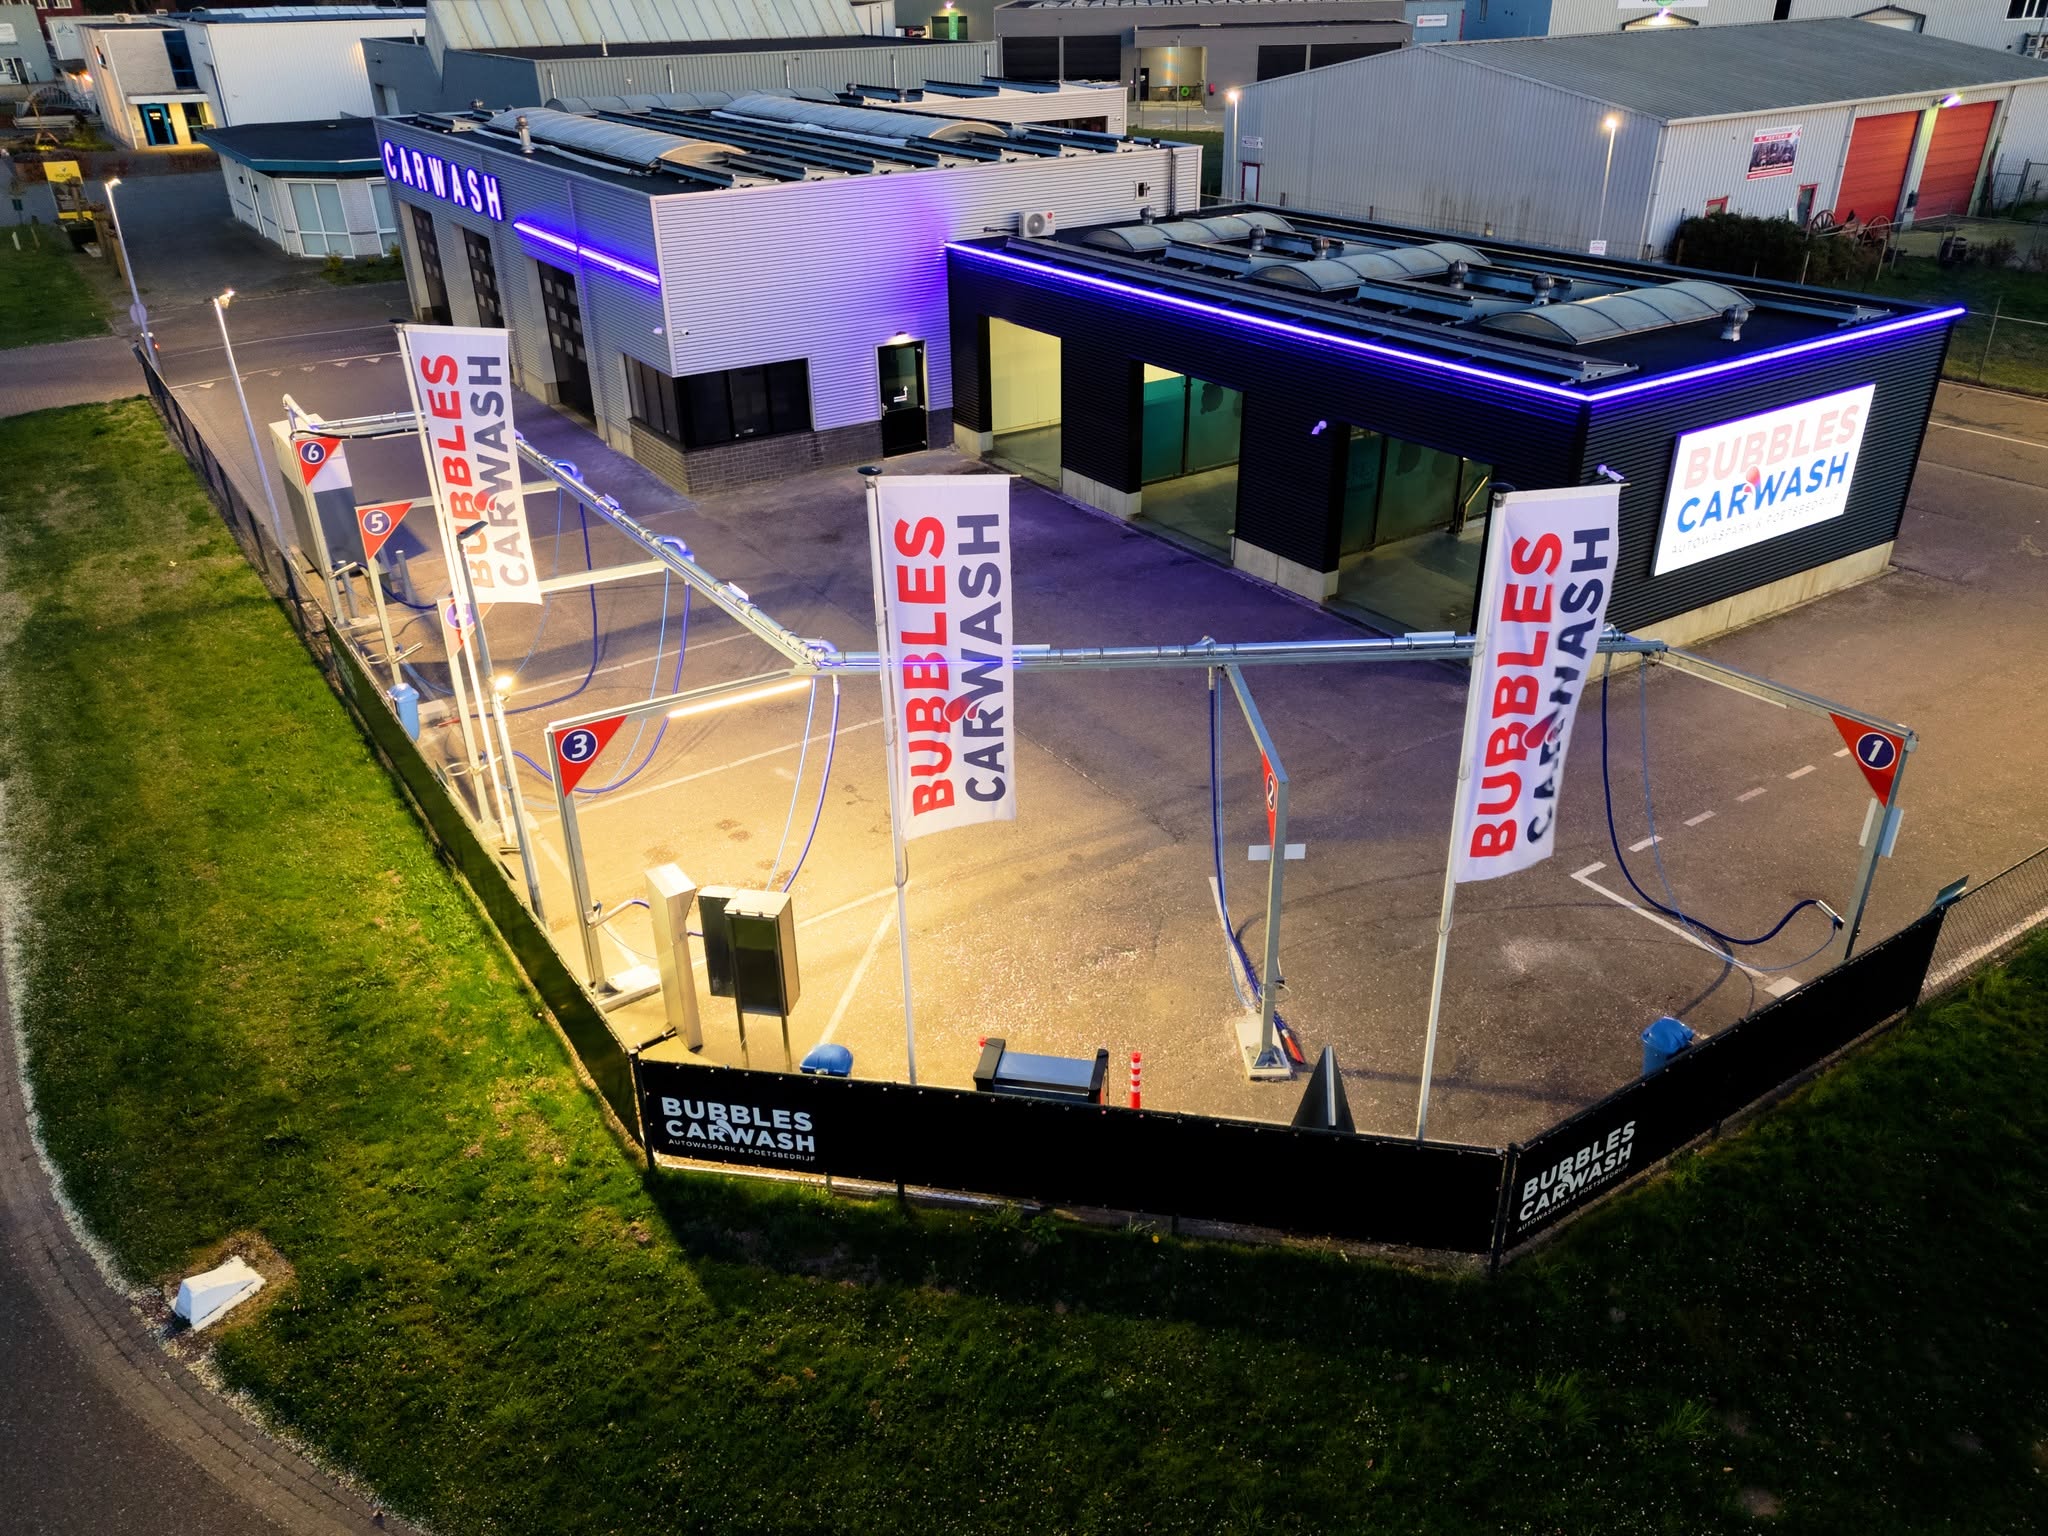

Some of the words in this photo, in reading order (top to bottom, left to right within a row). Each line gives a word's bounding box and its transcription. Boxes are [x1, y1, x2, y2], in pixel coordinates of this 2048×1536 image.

[383, 140, 502, 221] CARWASH
[308, 444, 319, 461] 6
[421, 354, 495, 589] BUBBLES
[467, 355, 529, 587] CARWASH
[1684, 404, 1860, 490] BUBBLES
[371, 514, 383, 531] 5
[1677, 451, 1849, 533] CARWASH
[893, 515, 955, 817] BUBBLES
[957, 513, 1006, 803] CARWASH
[1469, 532, 1563, 858] BUBBLES
[571, 734, 588, 759] 3
[1868, 739, 1884, 762] 1
[661, 1096, 813, 1132] BUBBLES
[665, 1119, 815, 1153] CARWASH
[668, 1138, 736, 1153] AUTOWASPARK
[748, 1148, 816, 1162] POETSBEDRIJF
[1519, 1142, 1633, 1221] CARWASH
[1522, 1120, 1636, 1202] BUBBLES
[1517, 1197, 1570, 1233] AUTOWASPARK
